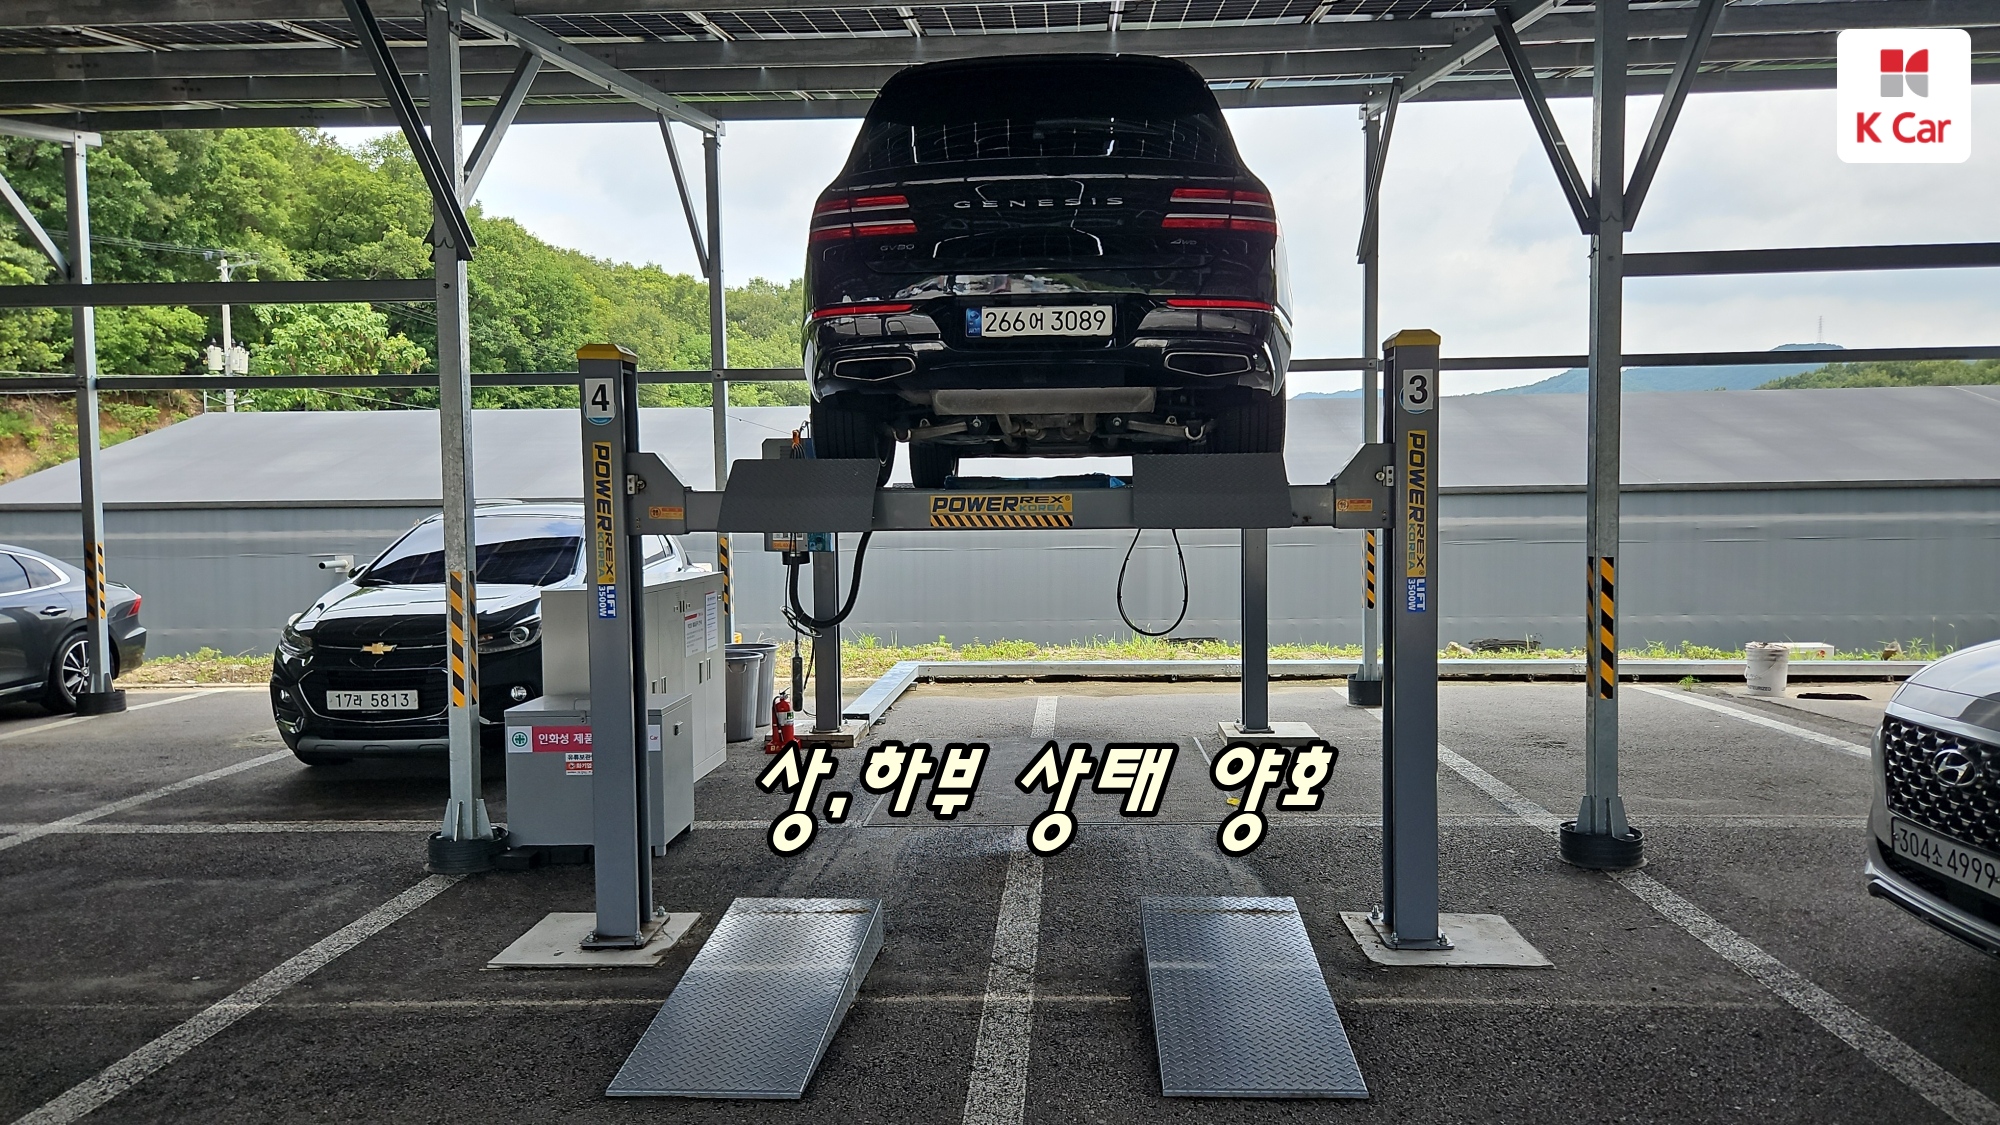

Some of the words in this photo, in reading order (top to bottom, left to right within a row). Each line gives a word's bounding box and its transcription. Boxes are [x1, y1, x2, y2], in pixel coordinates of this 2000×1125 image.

[953, 197, 1123, 208] GENESIS
[985, 311, 1043, 332] 266어
[1051, 310, 1106, 331] 3089
[591, 383, 610, 412] 4
[1409, 374, 1428, 404] 3
[1019, 504, 1065, 512] KOREA
[597, 532, 605, 578] KOREA
[1408, 523, 1416, 570] KOREA
[598, 586, 607, 617] 3500W
[606, 586, 616, 617] LIFT
[1408, 579, 1416, 612] 3500W
[1417, 579, 1425, 611] LIFT
[335, 693, 362, 708] 17라
[371, 693, 409, 708] 5813
[538, 733, 570, 745] 인화성
[1900, 828, 1943, 868] 304소
[1947, 849, 1996, 889] 4999
